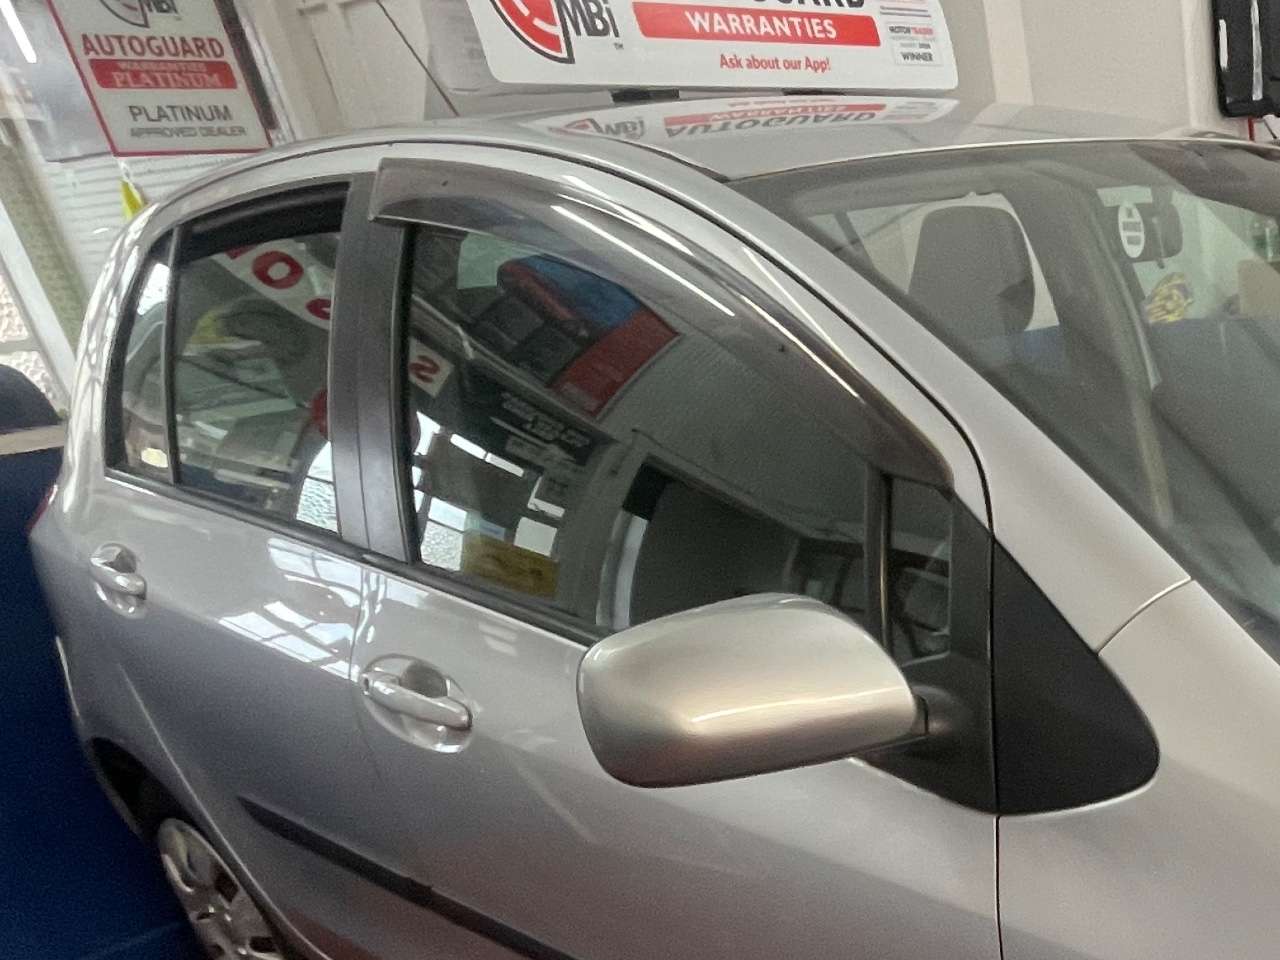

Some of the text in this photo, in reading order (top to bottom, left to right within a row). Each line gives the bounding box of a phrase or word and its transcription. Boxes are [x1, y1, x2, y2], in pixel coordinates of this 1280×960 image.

[685, 11, 837, 40] WARRANTIES
[81, 33, 225, 58] AUTOGUARD
[720, 54, 832, 73] Ask about our App!
[112, 72, 222, 88] PLATINUM
[128, 105, 234, 122] PLATINUM
[130, 126, 248, 138] APPROVED DEALER
